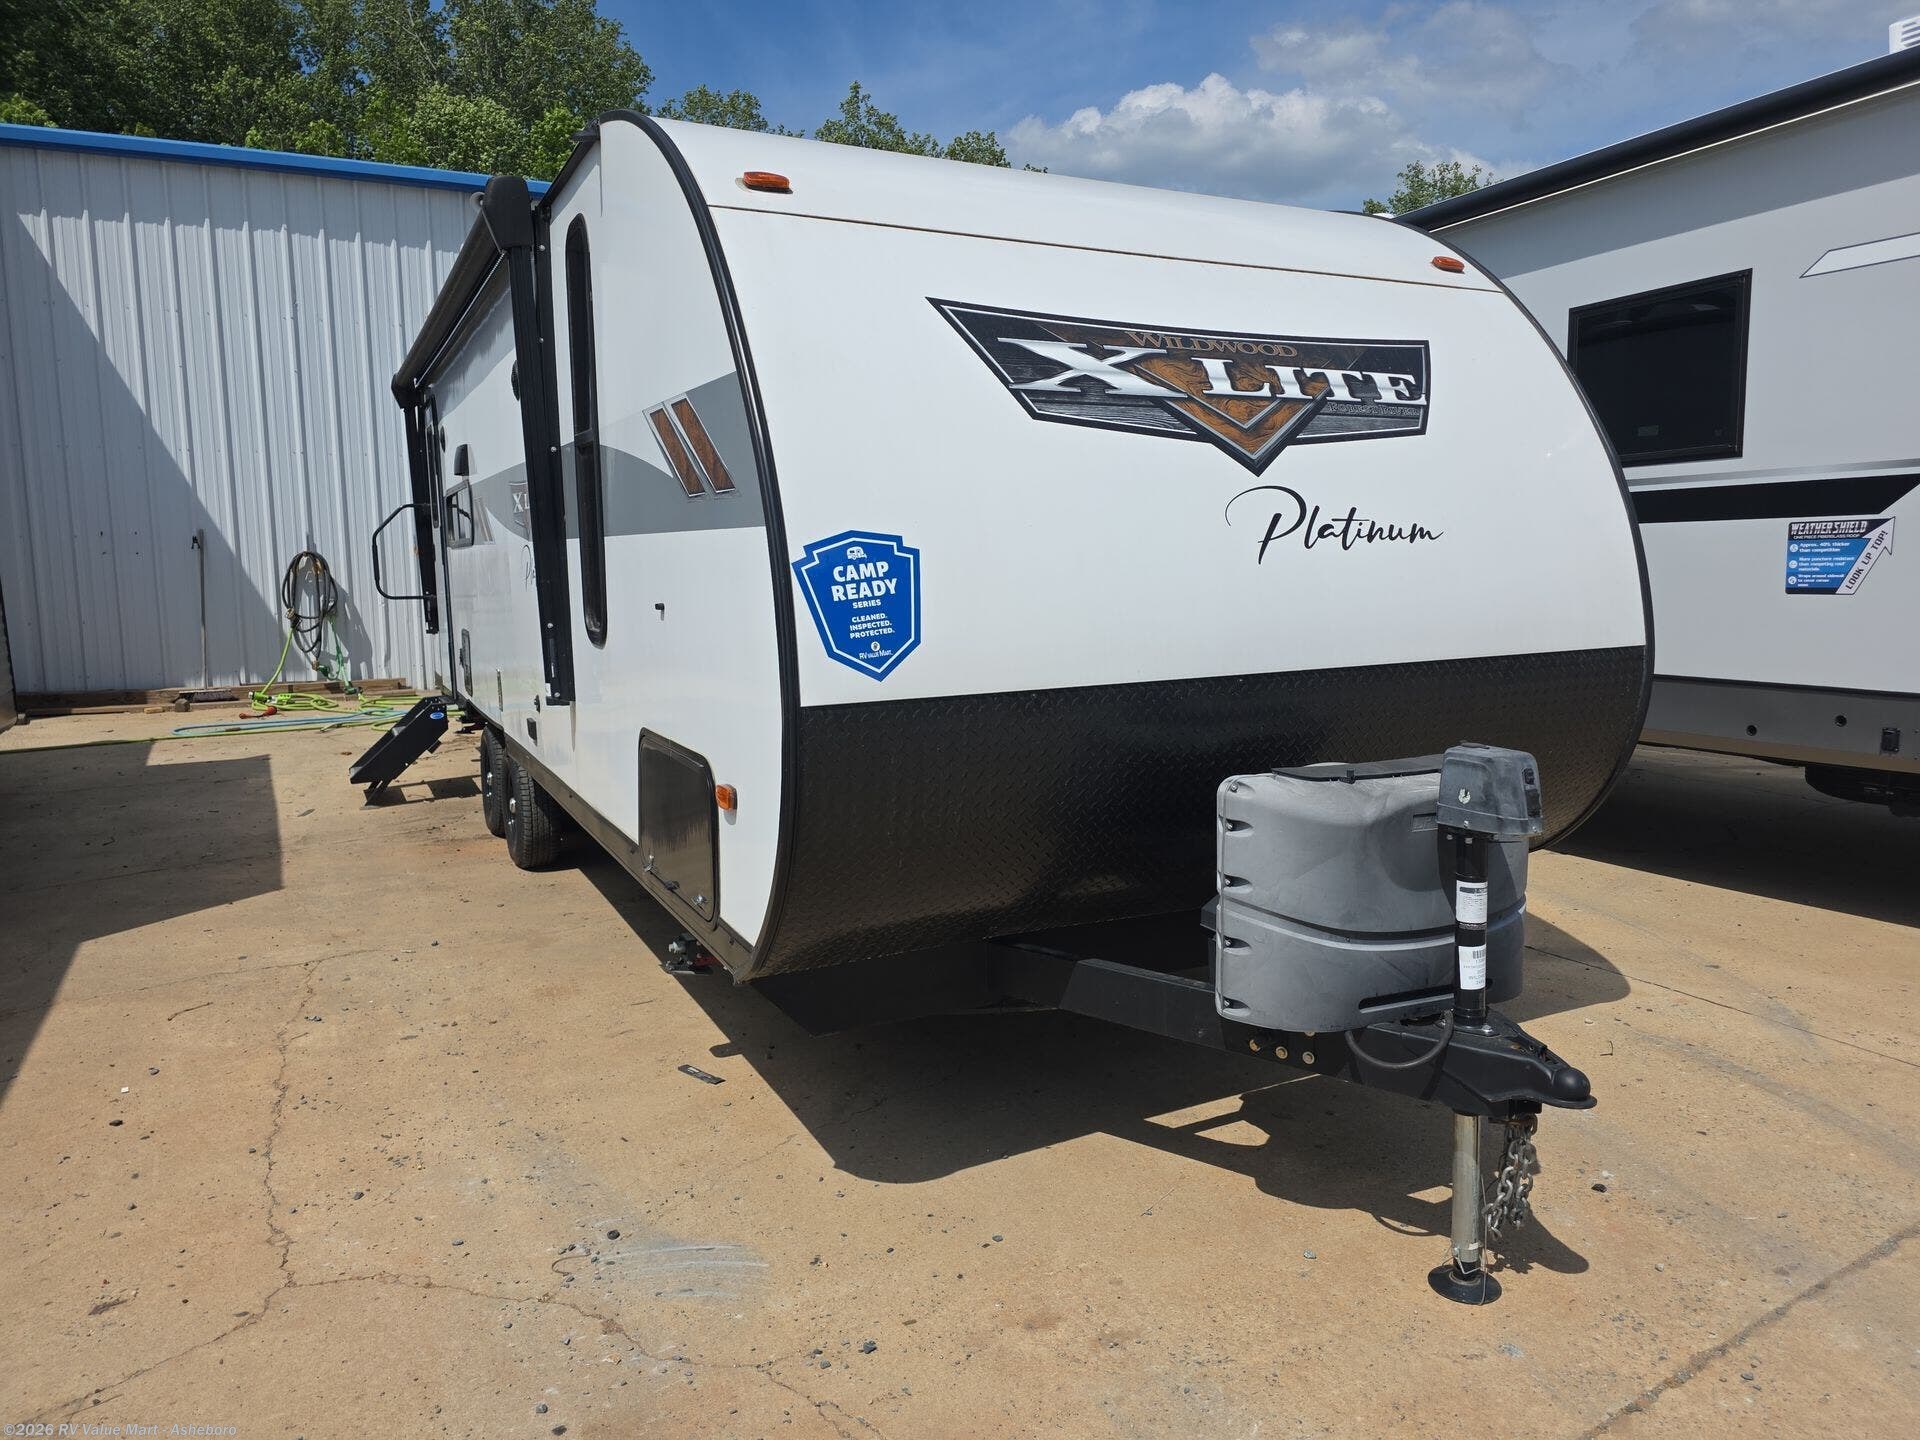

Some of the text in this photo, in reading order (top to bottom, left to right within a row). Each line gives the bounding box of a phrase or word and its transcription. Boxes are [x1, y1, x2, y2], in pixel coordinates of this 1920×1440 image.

[1125, 331, 1298, 357] WILDWOOD
[1225, 485, 1444, 565] Platinum
[1845, 530, 1889, 590] LOOK UP TOP!
[833, 561, 889, 582] CAMP
[831, 578, 897, 602] READY
[852, 599, 882, 609] SERIES
[850, 620, 892, 631] INSPECTED.
[851, 613, 888, 623] CLEANED.
[849, 627, 896, 639] PROTECTED.
